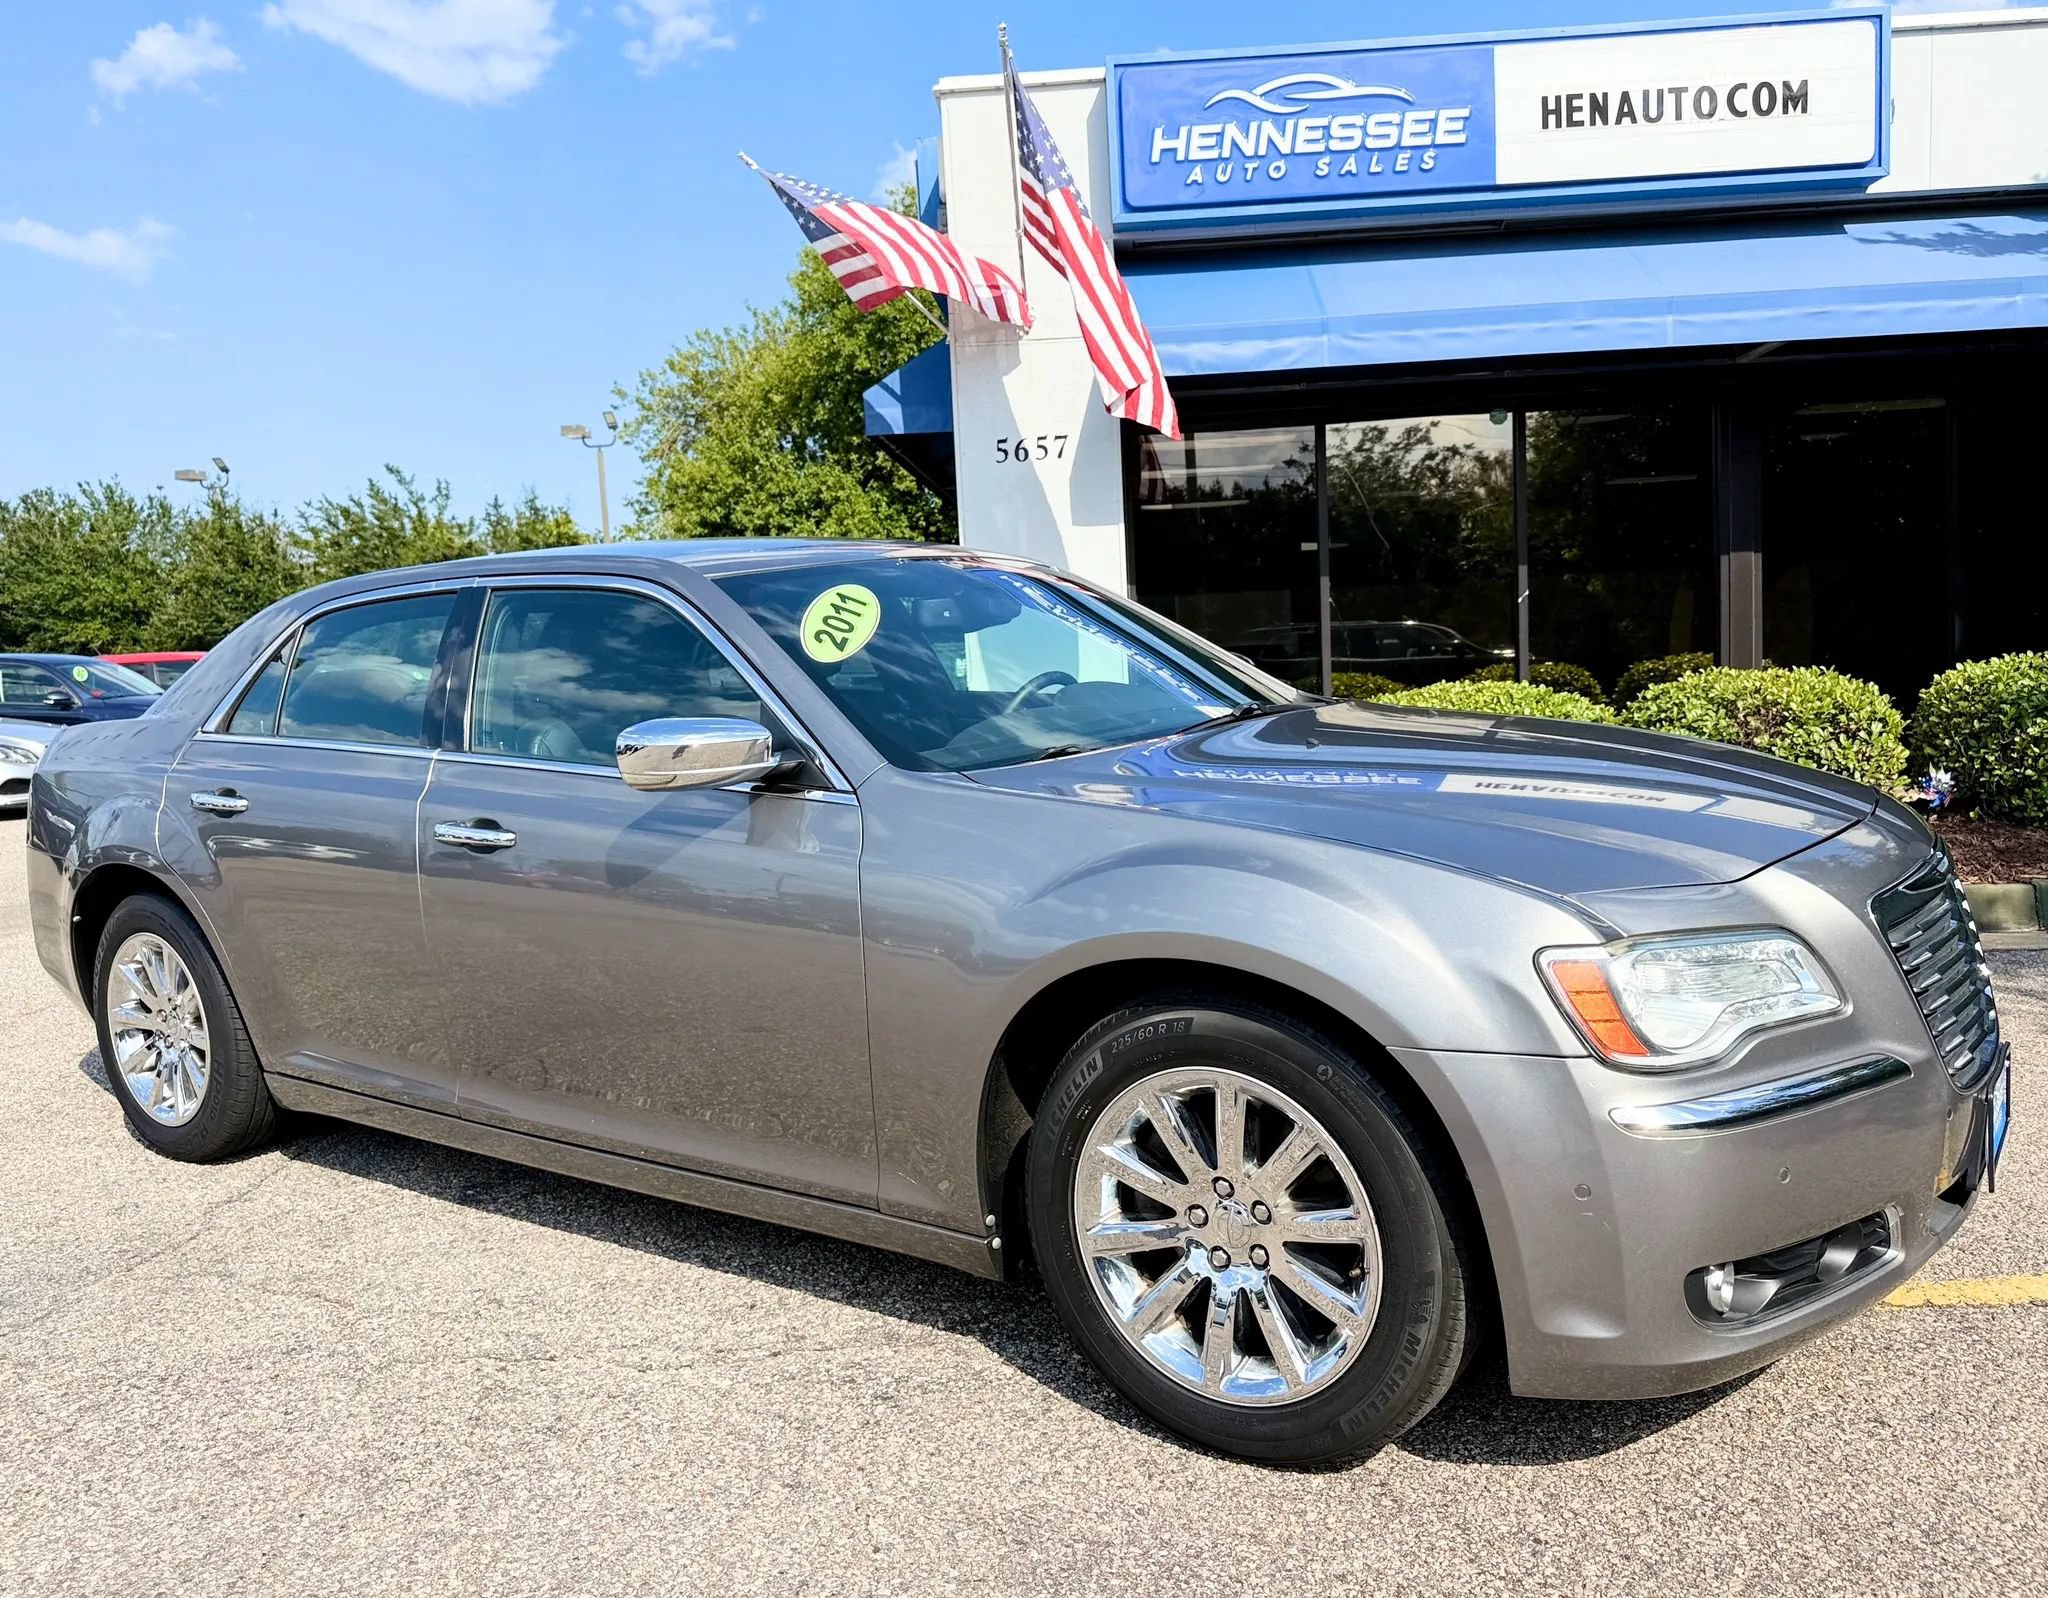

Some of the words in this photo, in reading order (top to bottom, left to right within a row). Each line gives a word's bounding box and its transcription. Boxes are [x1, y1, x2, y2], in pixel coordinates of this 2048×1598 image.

[1150, 104, 1472, 163] HENNESSEE
[1185, 159, 1288, 185] AUTO
[1314, 148, 1437, 176] SALES
[995, 434, 1068, 463] 5657
[814, 592, 868, 652] 2011
[1111, 1026, 1154, 1054] 225/60
[1158, 1023, 1167, 1035] R
[1173, 1021, 1185, 1033] 18
[1348, 1332, 1422, 1433] MICHELIN
